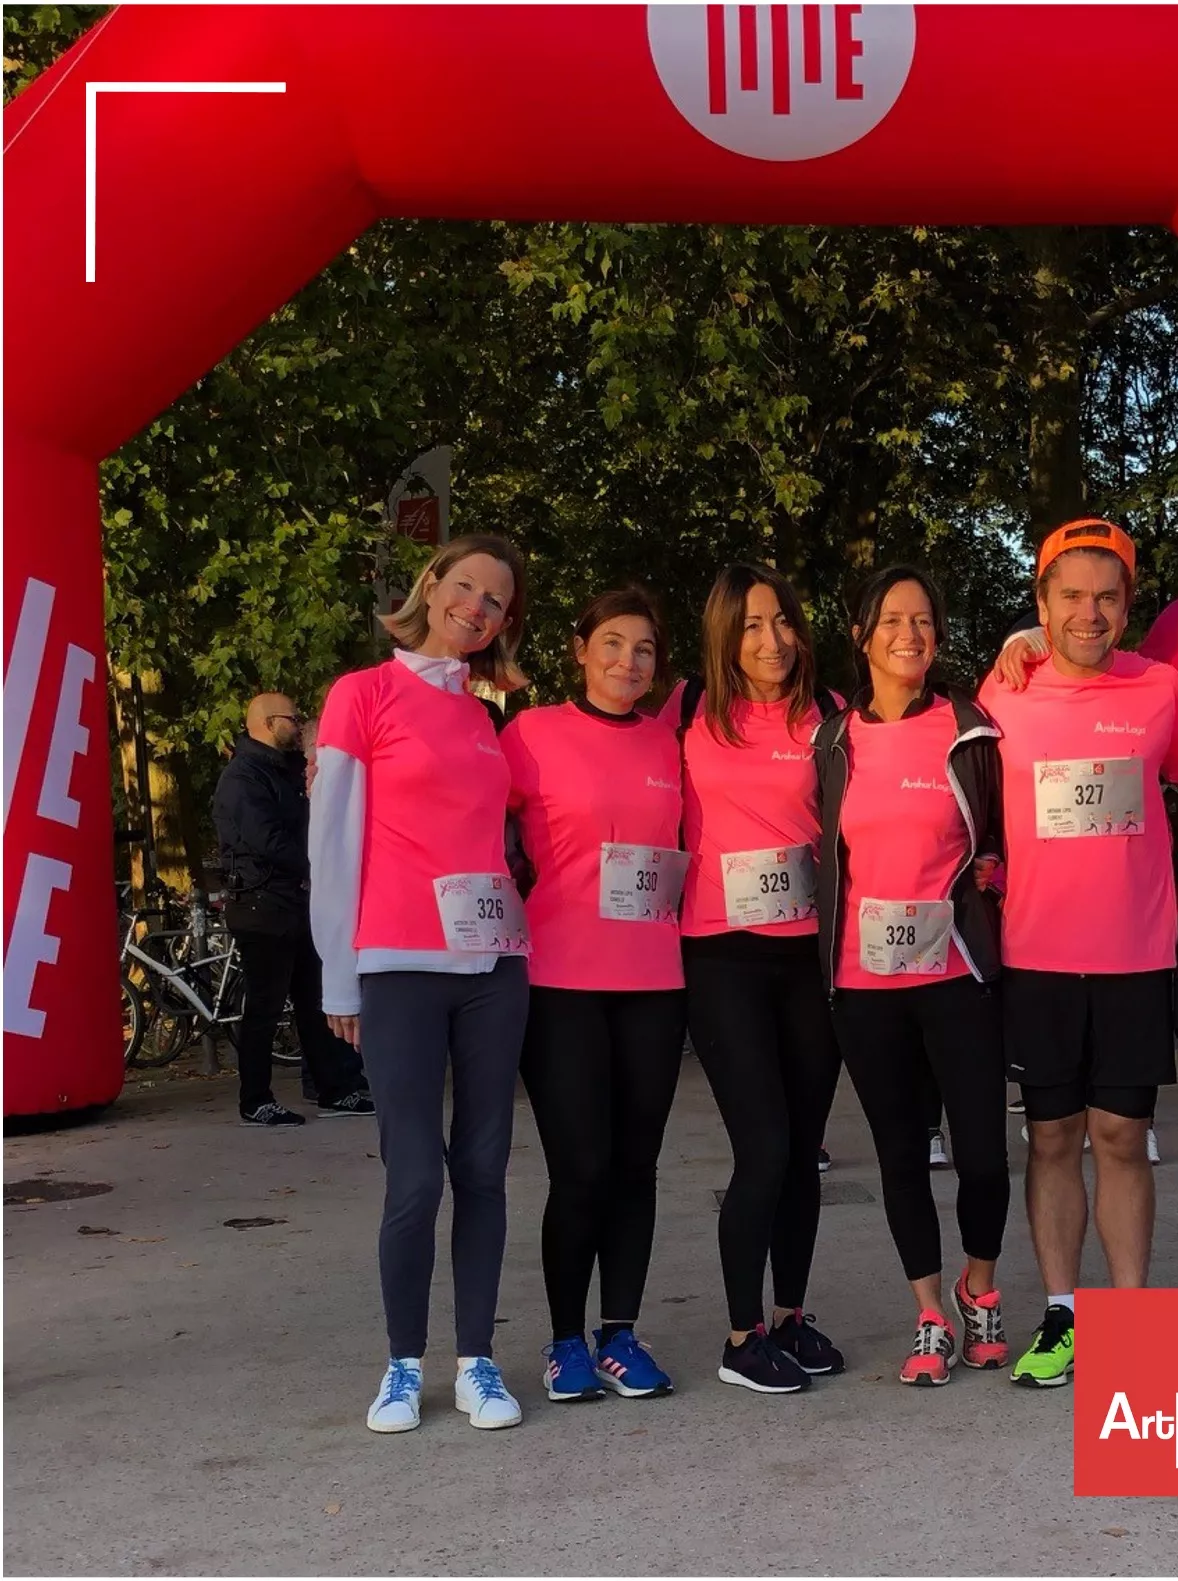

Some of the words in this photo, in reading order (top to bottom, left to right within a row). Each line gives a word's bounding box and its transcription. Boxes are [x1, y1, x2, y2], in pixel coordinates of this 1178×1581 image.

[1074, 784, 1104, 806] 327
[636, 870, 658, 892] 330
[759, 871, 790, 894] 329
[477, 898, 504, 919] 326
[886, 925, 916, 946] 328
